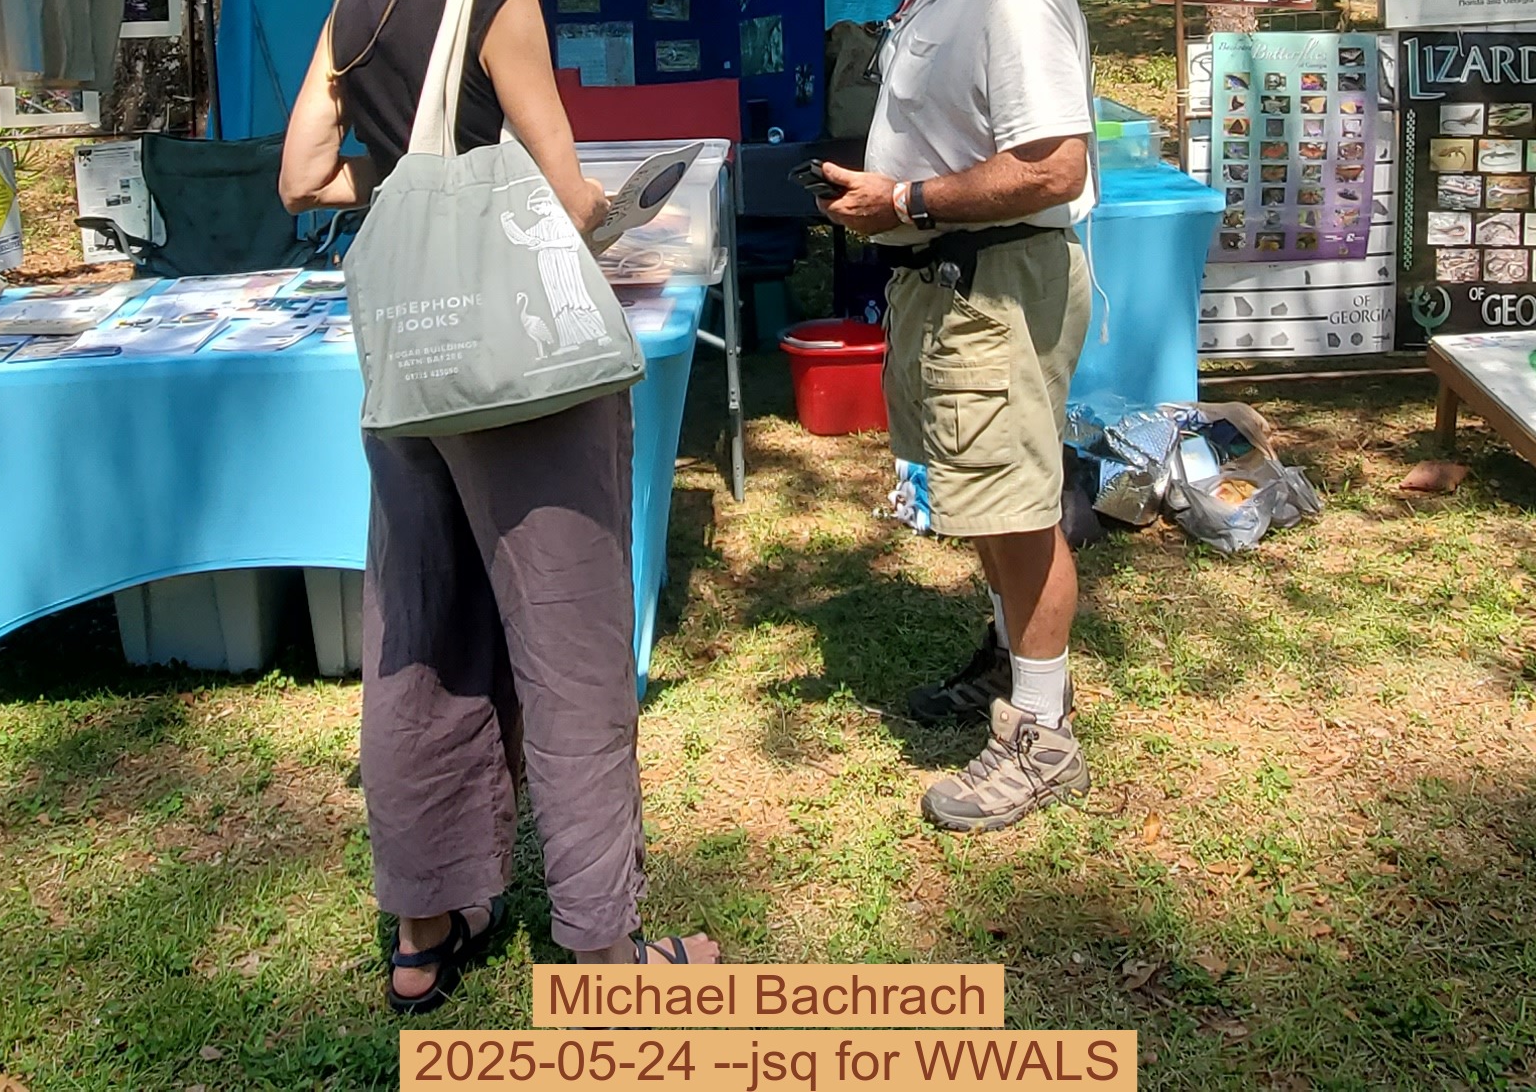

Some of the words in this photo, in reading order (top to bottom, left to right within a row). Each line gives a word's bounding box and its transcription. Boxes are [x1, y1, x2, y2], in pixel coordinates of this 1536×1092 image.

[1353, 294, 1372, 307] OF
[1468, 287, 1485, 301] OF
[397, 313, 459, 334] BOOKS
[1329, 307, 1394, 325] GEORGIA
